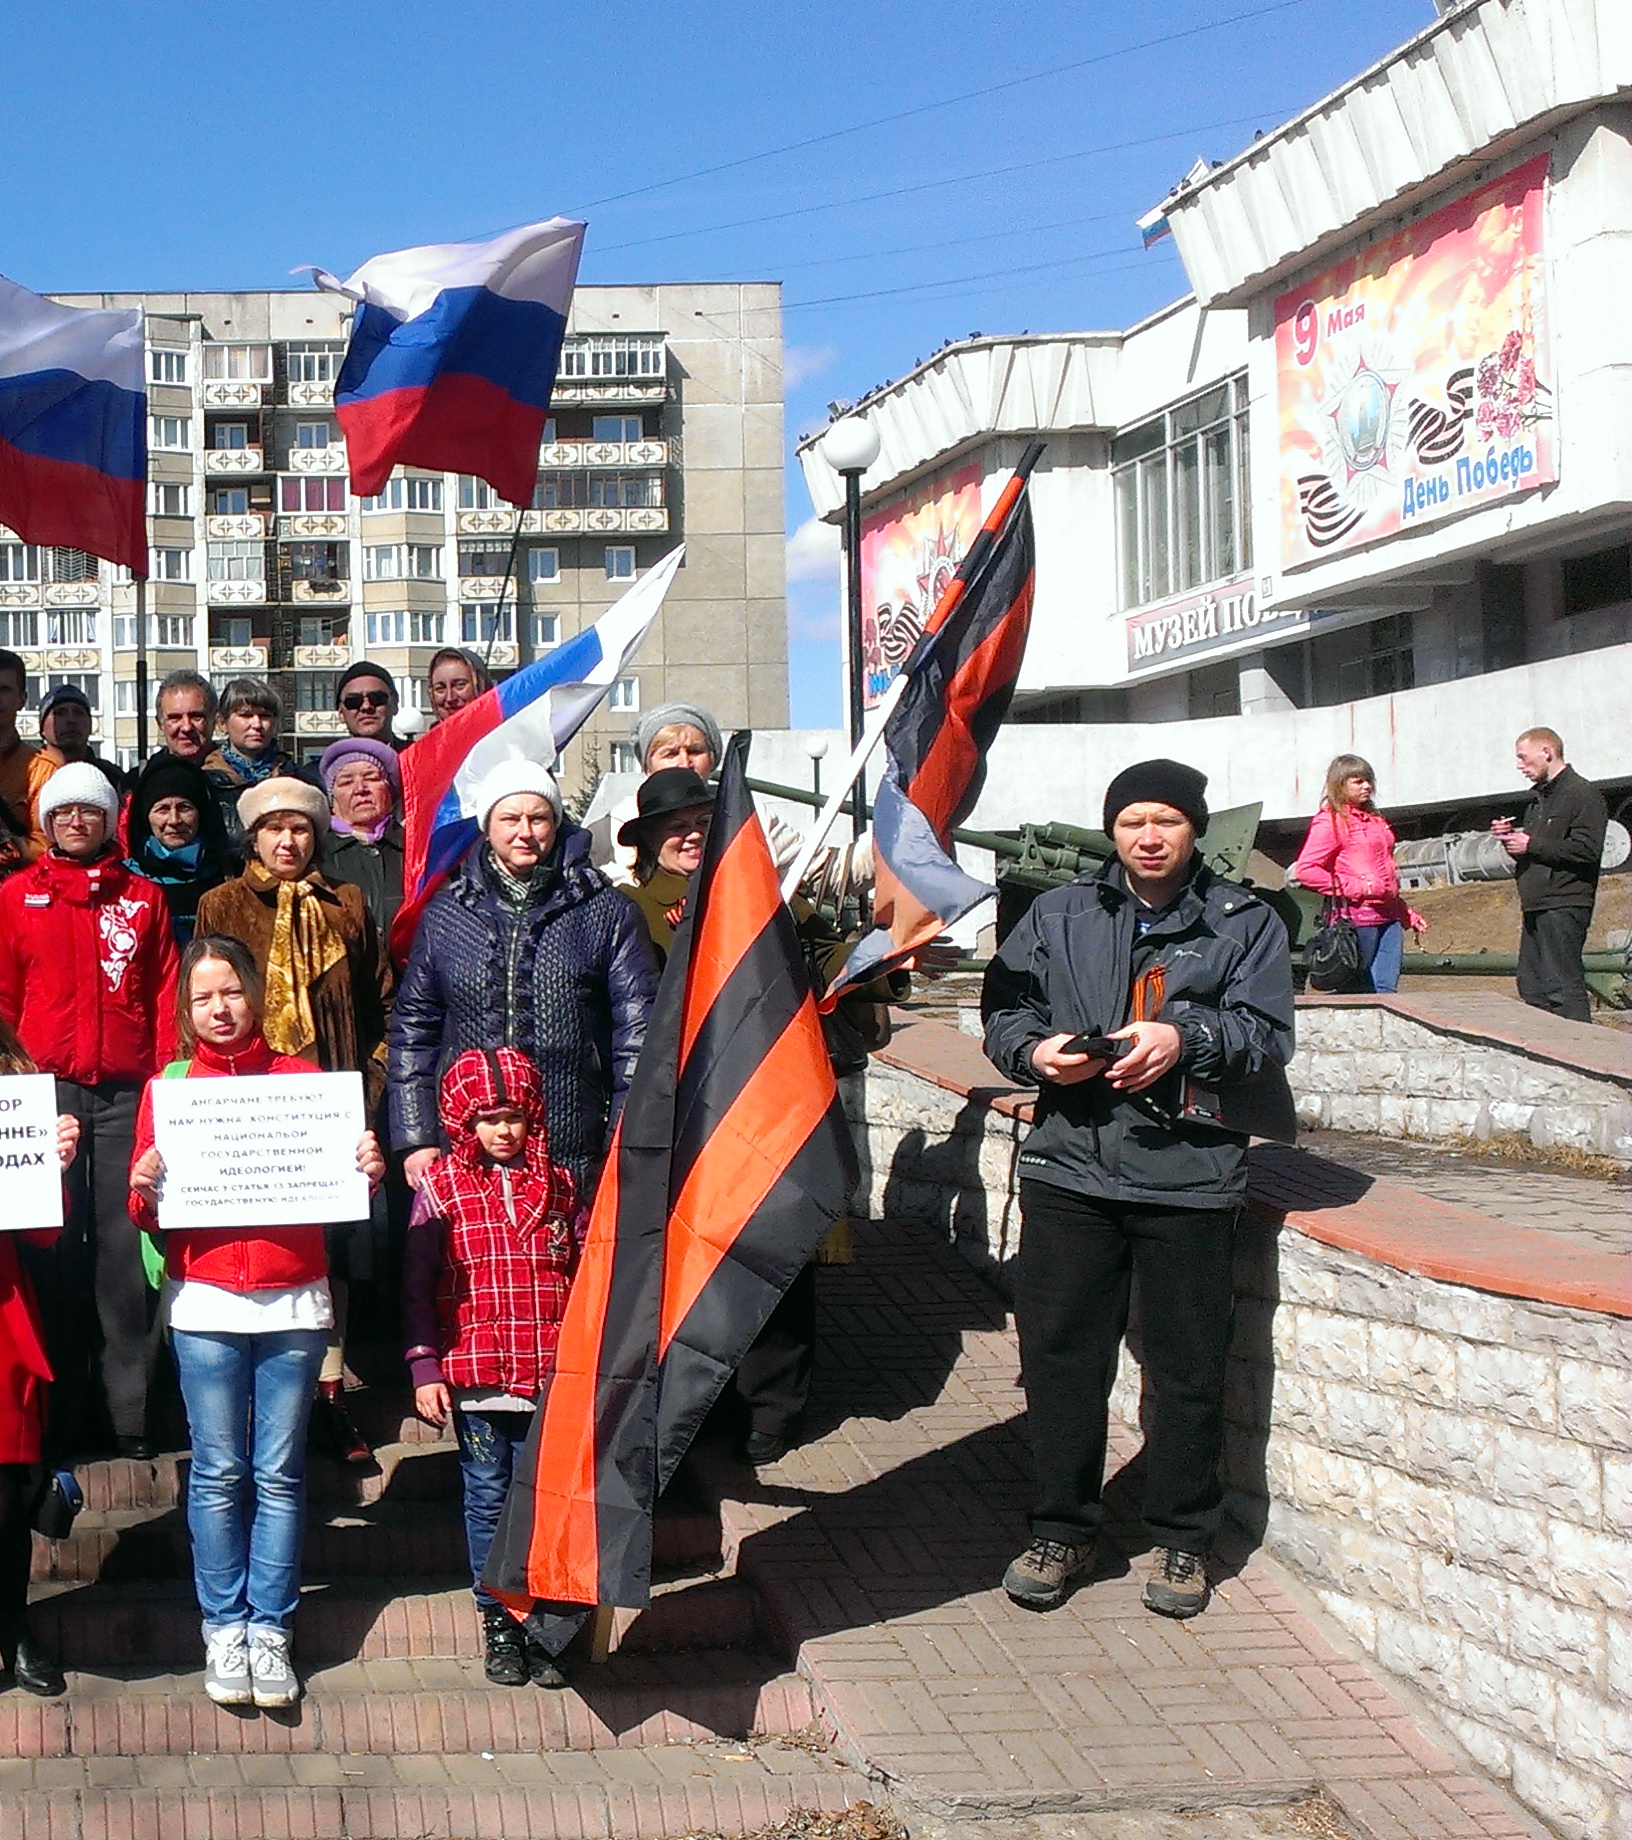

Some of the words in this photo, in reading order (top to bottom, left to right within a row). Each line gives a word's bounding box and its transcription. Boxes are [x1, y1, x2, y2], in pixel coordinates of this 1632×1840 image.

[1295, 301, 1318, 366] 9
[1327, 303, 1365, 338] Мая
[1403, 475, 1449, 520] День
[1132, 593, 1218, 660] МУЗЕЙ
[169, 1118, 194, 1126] НАМ
[250, 1111, 340, 1122] КОНСТИТУЦИЯ
